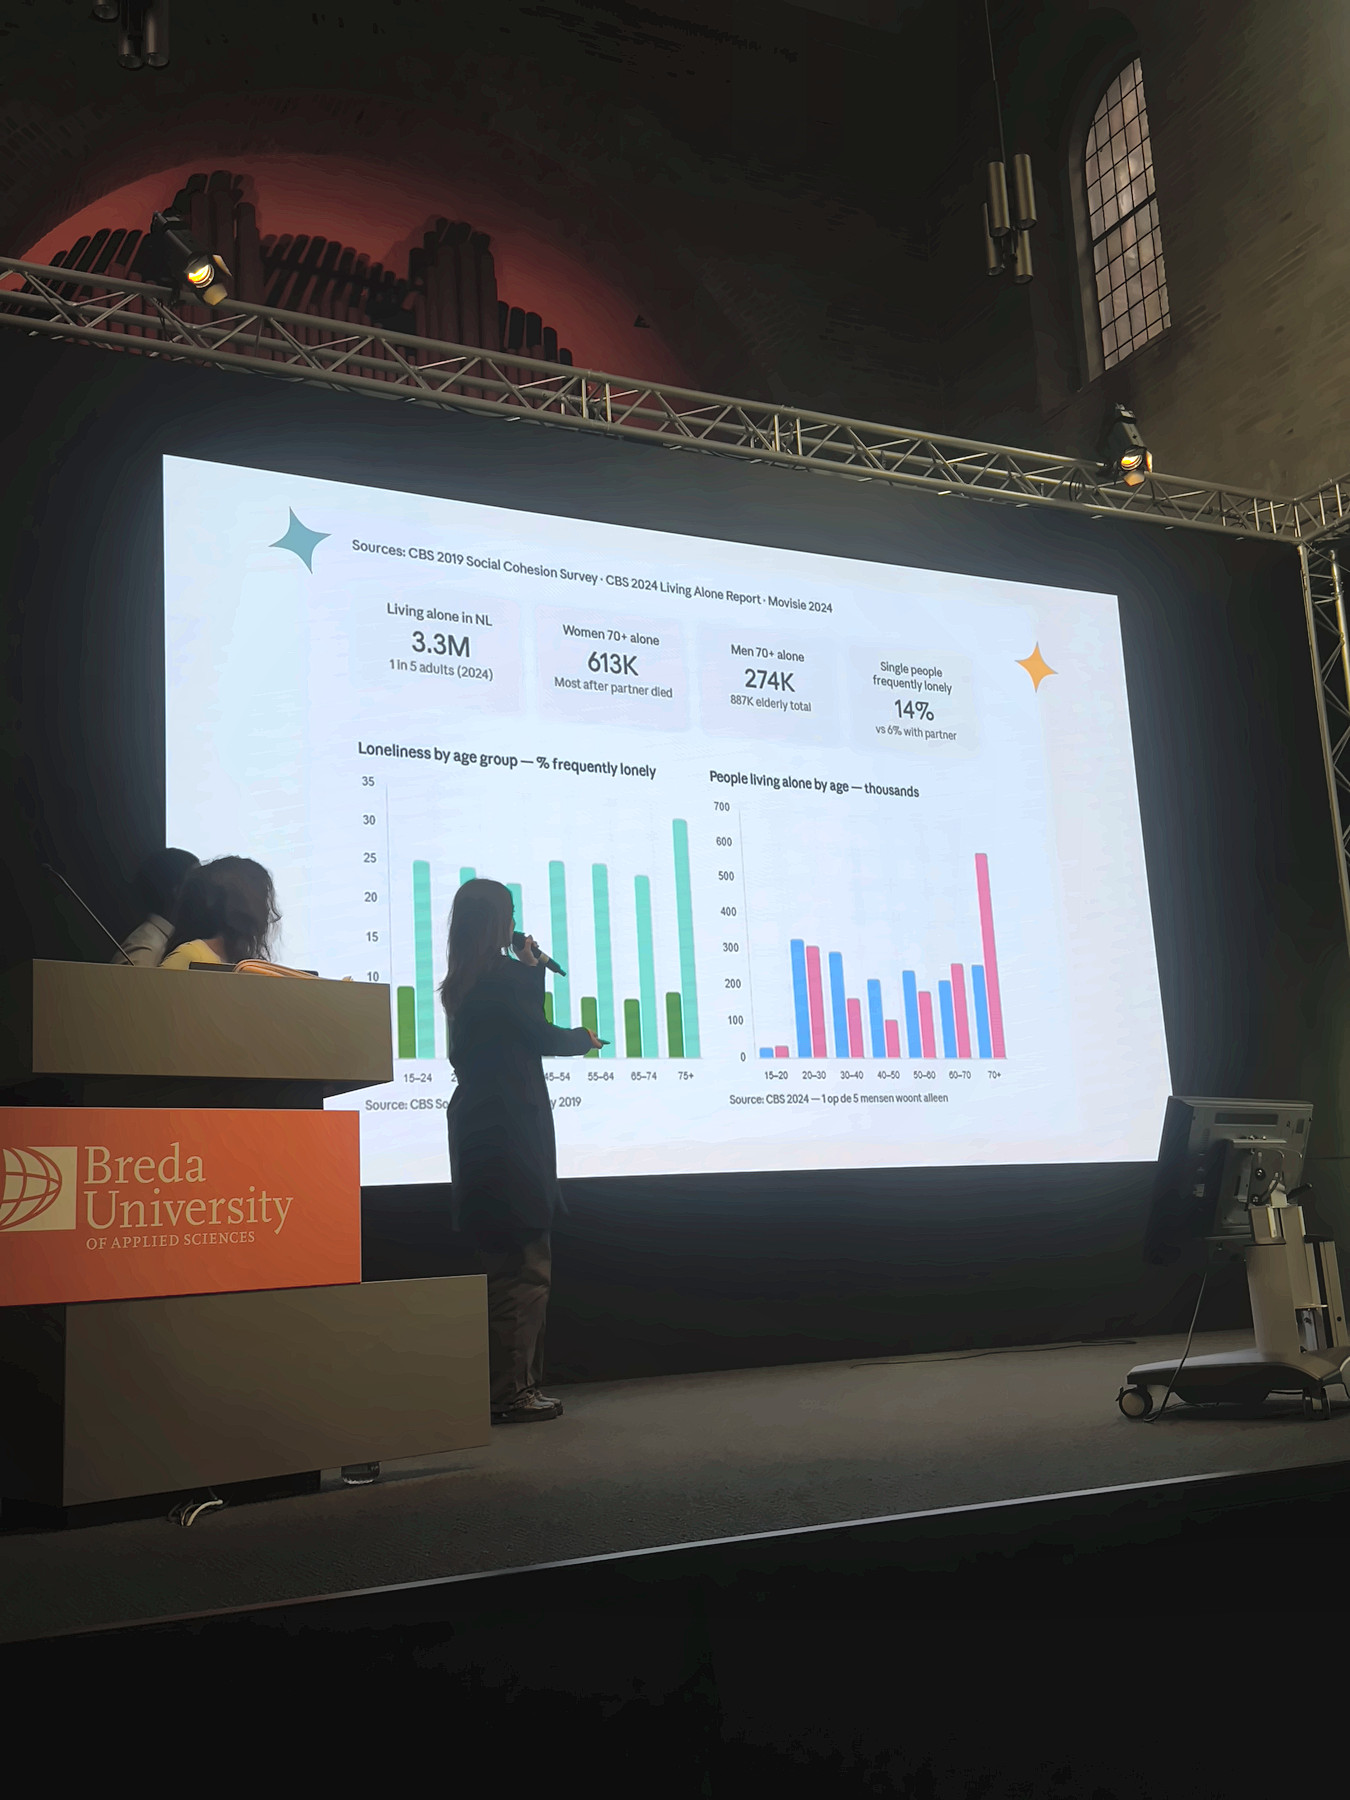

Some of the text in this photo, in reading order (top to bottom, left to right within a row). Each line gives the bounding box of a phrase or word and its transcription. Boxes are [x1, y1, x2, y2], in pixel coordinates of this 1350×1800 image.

[353, 540, 405, 557] Sources:
[409, 548, 434, 561] CBS
[437, 552, 464, 565] 2019
[467, 556, 500, 570] Social
[503, 561, 557, 578] Cohesion
[560, 569, 598, 585] Survey
[606, 575, 629, 587] CBS
[632, 579, 658, 590] 2024
[660, 582, 692, 598] Living
[694, 586, 723, 599] Alone
[726, 590, 761, 606] Report
[768, 596, 806, 610] Movisie
[809, 601, 832, 613] 2024
[388, 603, 492, 626] Living alone in NL
[563, 625, 659, 645] Women 70+ alone
[412, 631, 469, 657] 3.3M
[731, 644, 804, 662] Men 70+ alone
[390, 659, 493, 681] 1 in 5 adults (2024)
[588, 651, 638, 676] 613K
[881, 662, 943, 679] Single people
[555, 677, 672, 698] Most after partner died
[745, 669, 795, 692] 274K
[873, 675, 952, 695] frequently lonely
[731, 695, 811, 712] 887K elderly total
[895, 700, 934, 721] 14%
[876, 725, 956, 740] vs 6% with partner
[359, 742, 431, 759] Loneliness
[434, 747, 450, 764] by
[454, 752, 477, 766] age
[480, 754, 518, 770] group
[536, 757, 550, 769] %
[552, 758, 618, 777] frequently
[620, 763, 656, 780] lonely
[362, 776, 374, 786] 35
[710, 771, 748, 787] People
[750, 773, 780, 789] living
[783, 776, 812, 789] alone
[814, 778, 827, 793] by
[830, 782, 849, 794] age
[864, 783, 919, 797] thousands
[714, 802, 730, 811] 700
[363, 815, 375, 825] 30
[716, 837, 732, 846] 600
[364, 852, 376, 863] 25
[719, 871, 734, 881] 500
[365, 892, 377, 902] 20
[721, 907, 736, 916] 400
[367, 932, 378, 942] 15
[723, 942, 739, 952] 300
[367, 971, 380, 981] 10
[725, 979, 741, 988] 200
[728, 1015, 743, 1025] 100
[741, 1052, 746, 1062] 0
[678, 1071, 694, 1080] 75+
[988, 1071, 1001, 1079] 70+
[366, 1100, 407, 1110] Source:
[410, 1099, 433, 1110] CBS
[559, 1097, 581, 1107] 2019
[730, 1095, 764, 1104] Source:
[766, 1094, 785, 1104] CBS
[787, 1094, 809, 1104] 2024
[822, 1094, 826, 1103] 1
[827, 1096, 839, 1106] op
[840, 1094, 851, 1103] de
[853, 1093, 858, 1103] 5
[861, 1095, 895, 1103] mensen
[895, 1094, 922, 1102] woont
[924, 1093, 948, 1102] alleen
[84, 1141, 206, 1185] Breda
[85, 1186, 293, 1235] University
[86, 1231, 255, 1251] OF APPLIED SCIENCES
